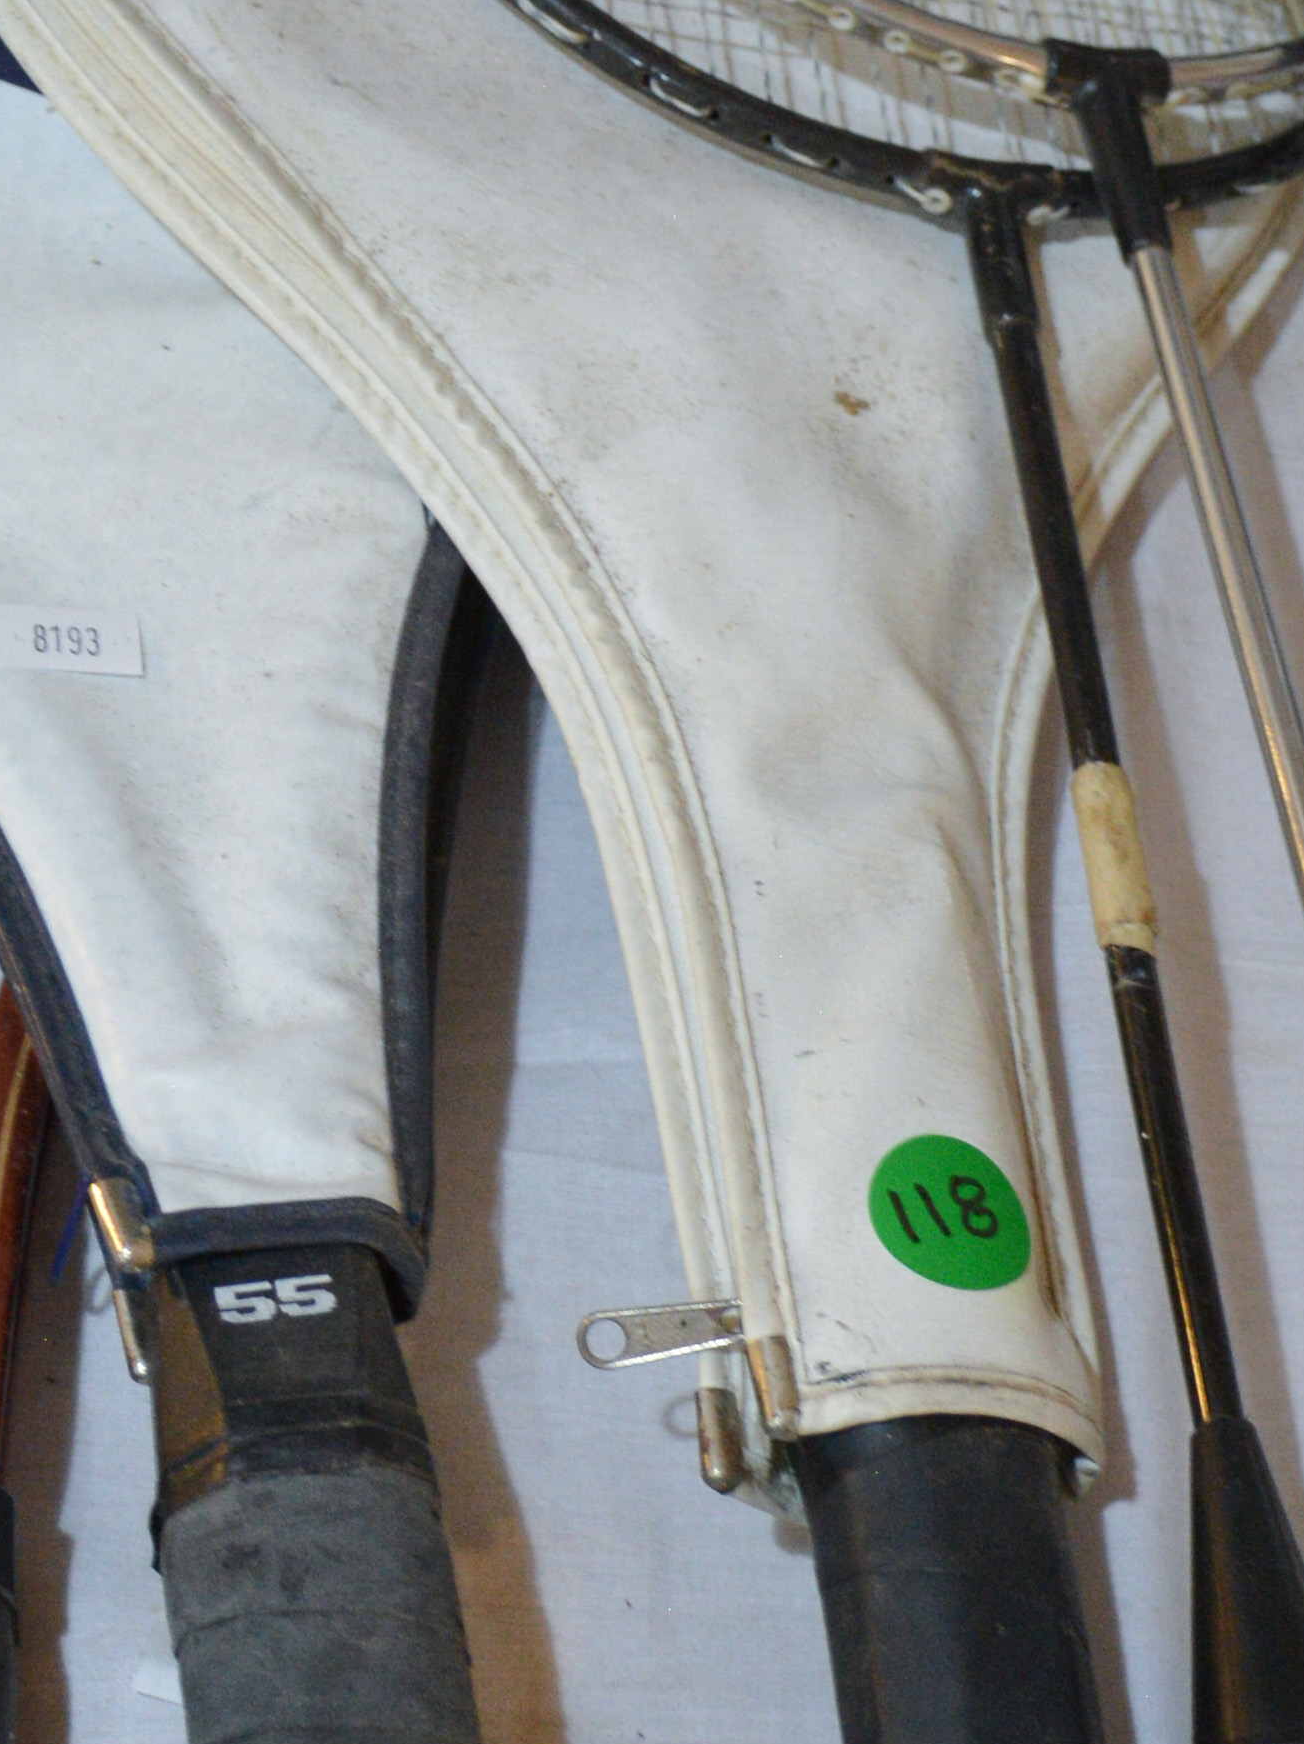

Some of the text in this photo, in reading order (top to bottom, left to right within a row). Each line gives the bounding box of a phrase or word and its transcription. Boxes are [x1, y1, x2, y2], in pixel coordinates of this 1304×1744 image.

[33, 624, 100, 656] 8193
[887, 1174, 999, 1244] 118
[213, 1273, 338, 1324] 55
